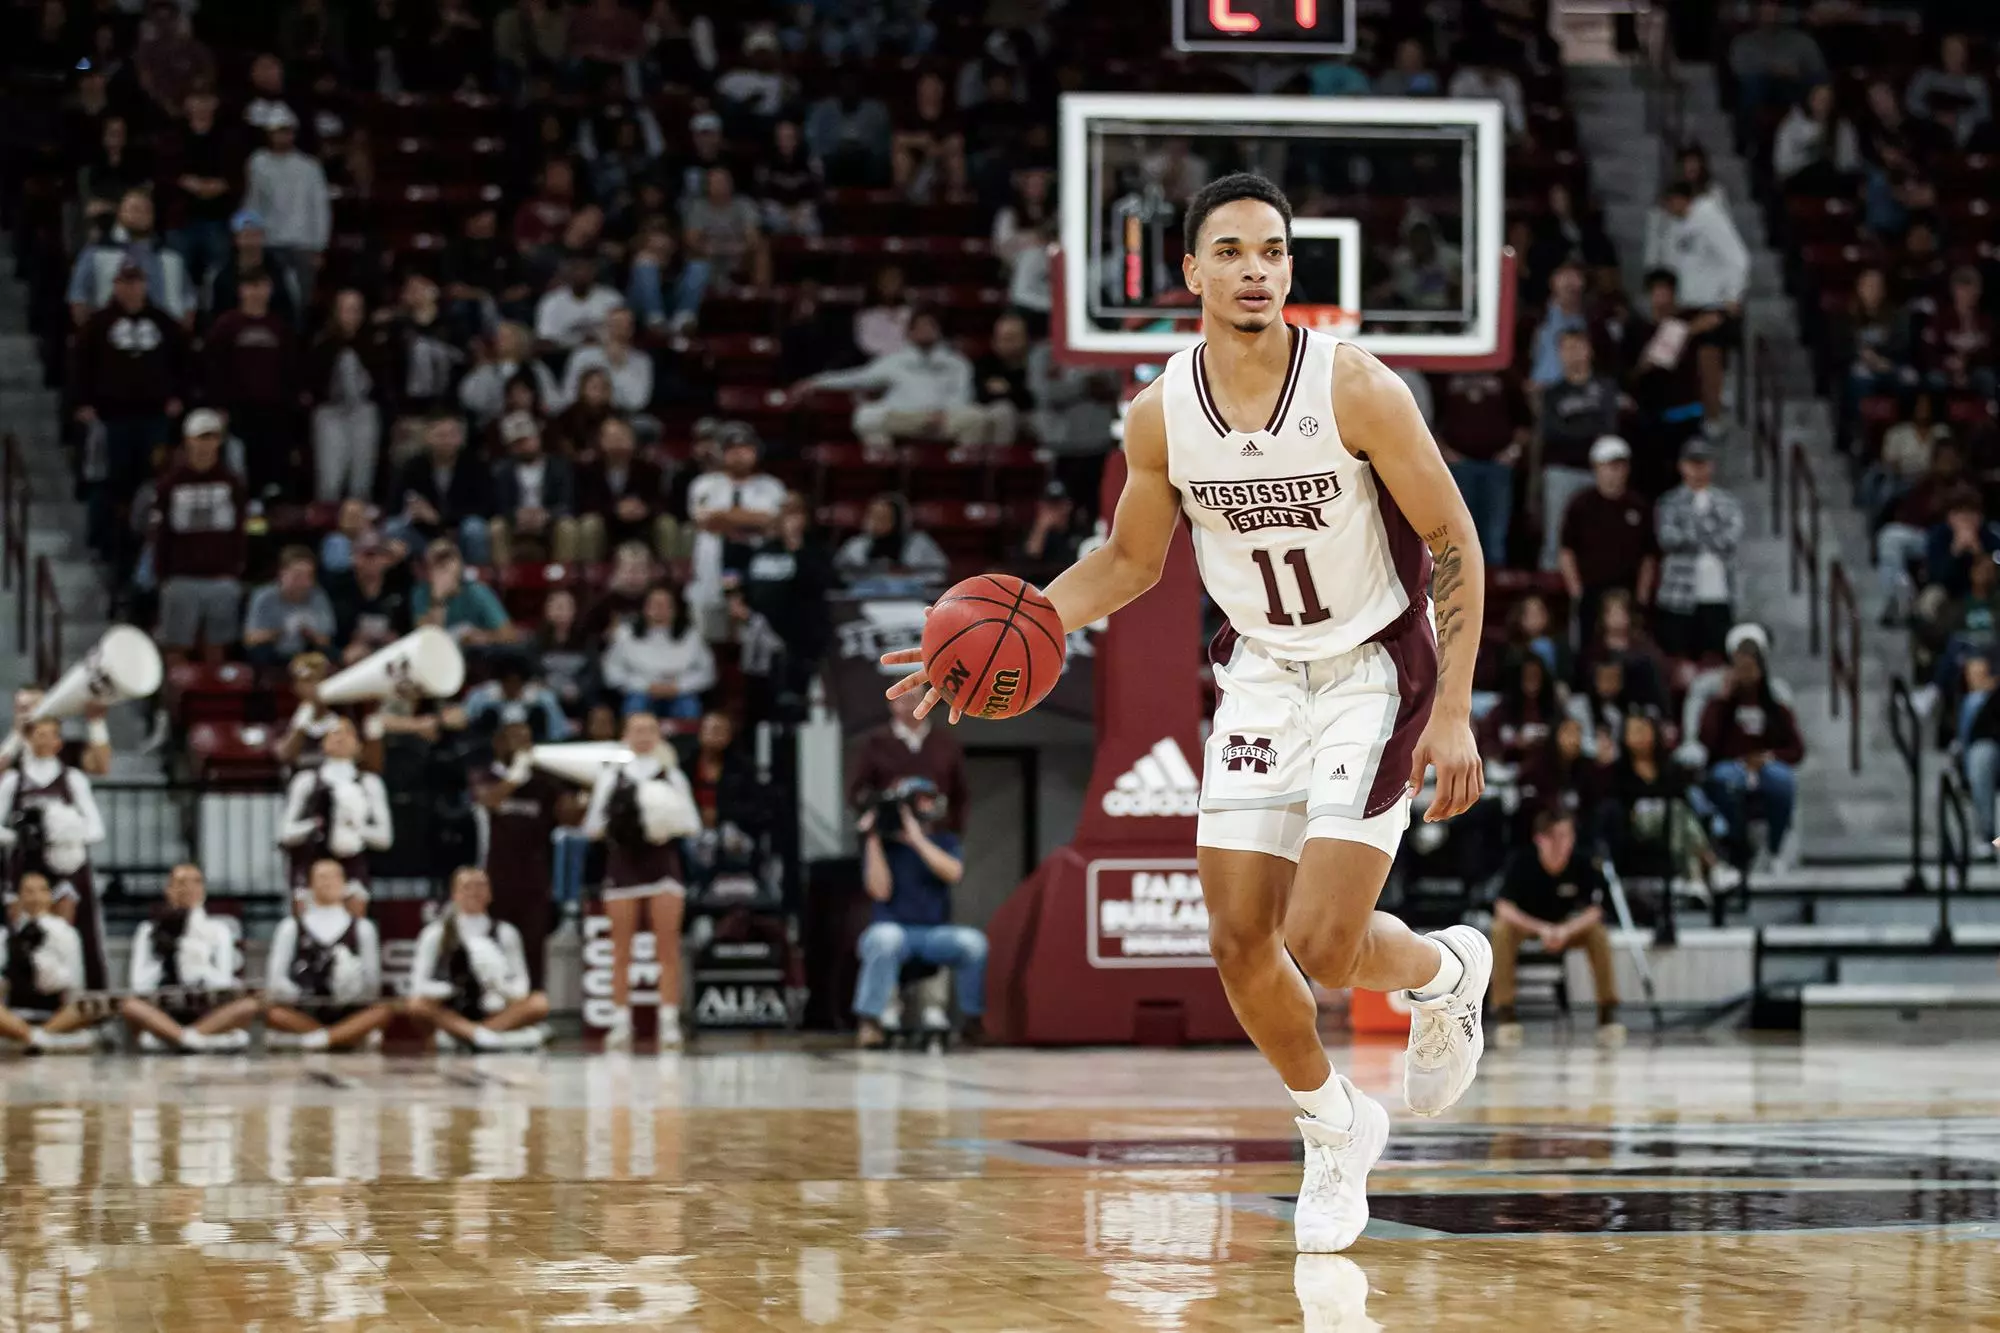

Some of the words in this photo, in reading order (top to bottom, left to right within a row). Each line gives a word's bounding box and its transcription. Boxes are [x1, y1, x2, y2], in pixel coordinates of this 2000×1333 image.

[1190, 475, 1342, 506] MISSISSIPPI
[1238, 509, 1308, 530] STATE
[1251, 548, 1332, 626] 11
[1231, 747, 1267, 761] STATE
[1102, 786, 1200, 817] adida
